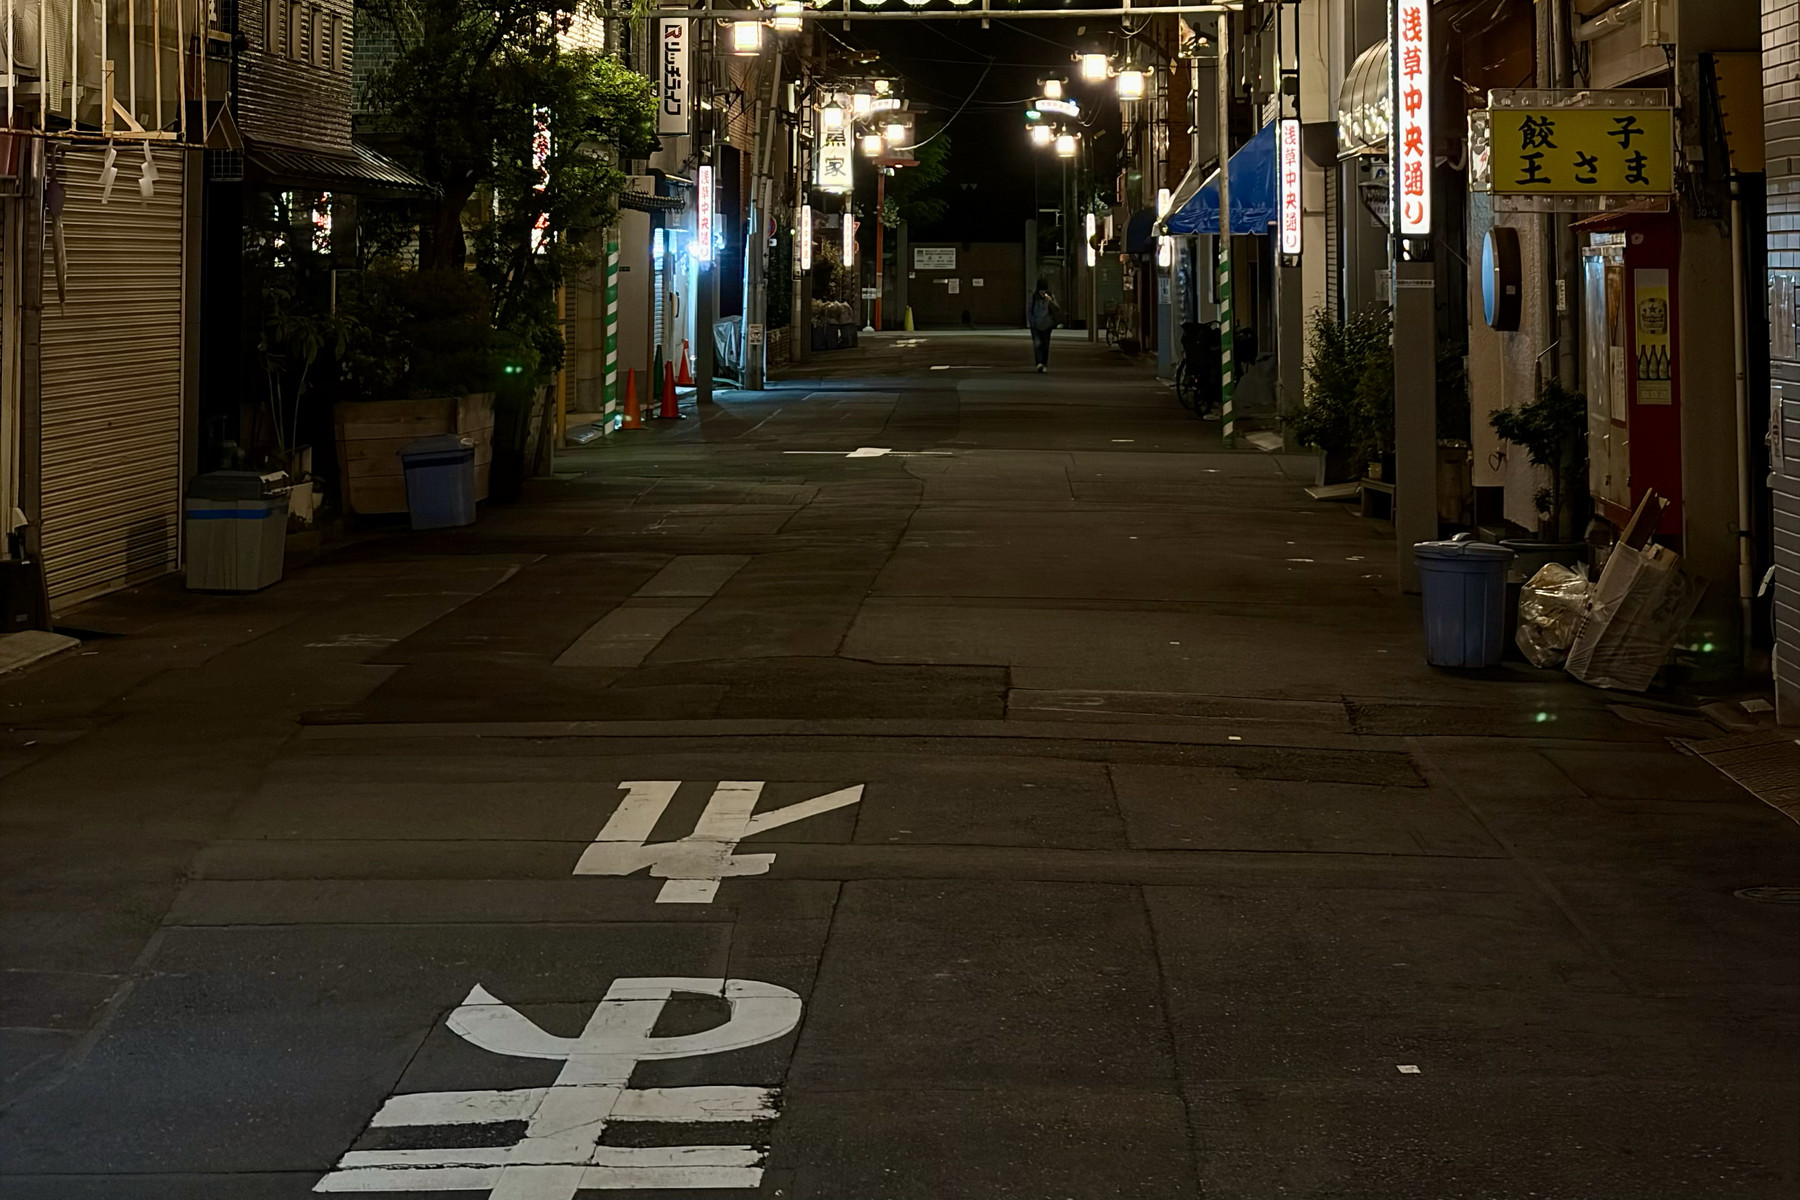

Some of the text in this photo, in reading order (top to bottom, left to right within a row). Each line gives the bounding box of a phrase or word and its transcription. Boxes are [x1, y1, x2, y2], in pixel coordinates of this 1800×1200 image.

[664, 41, 681, 116] リッチライフ
[1403, 6, 1425, 226] 浅草中央通り
[1518, 114, 1645, 150] 餃子
[824, 130, 846, 176] 黒家
[1515, 151, 1650, 186] 王さま
[1284, 125, 1298, 248] 浅草中央通り
